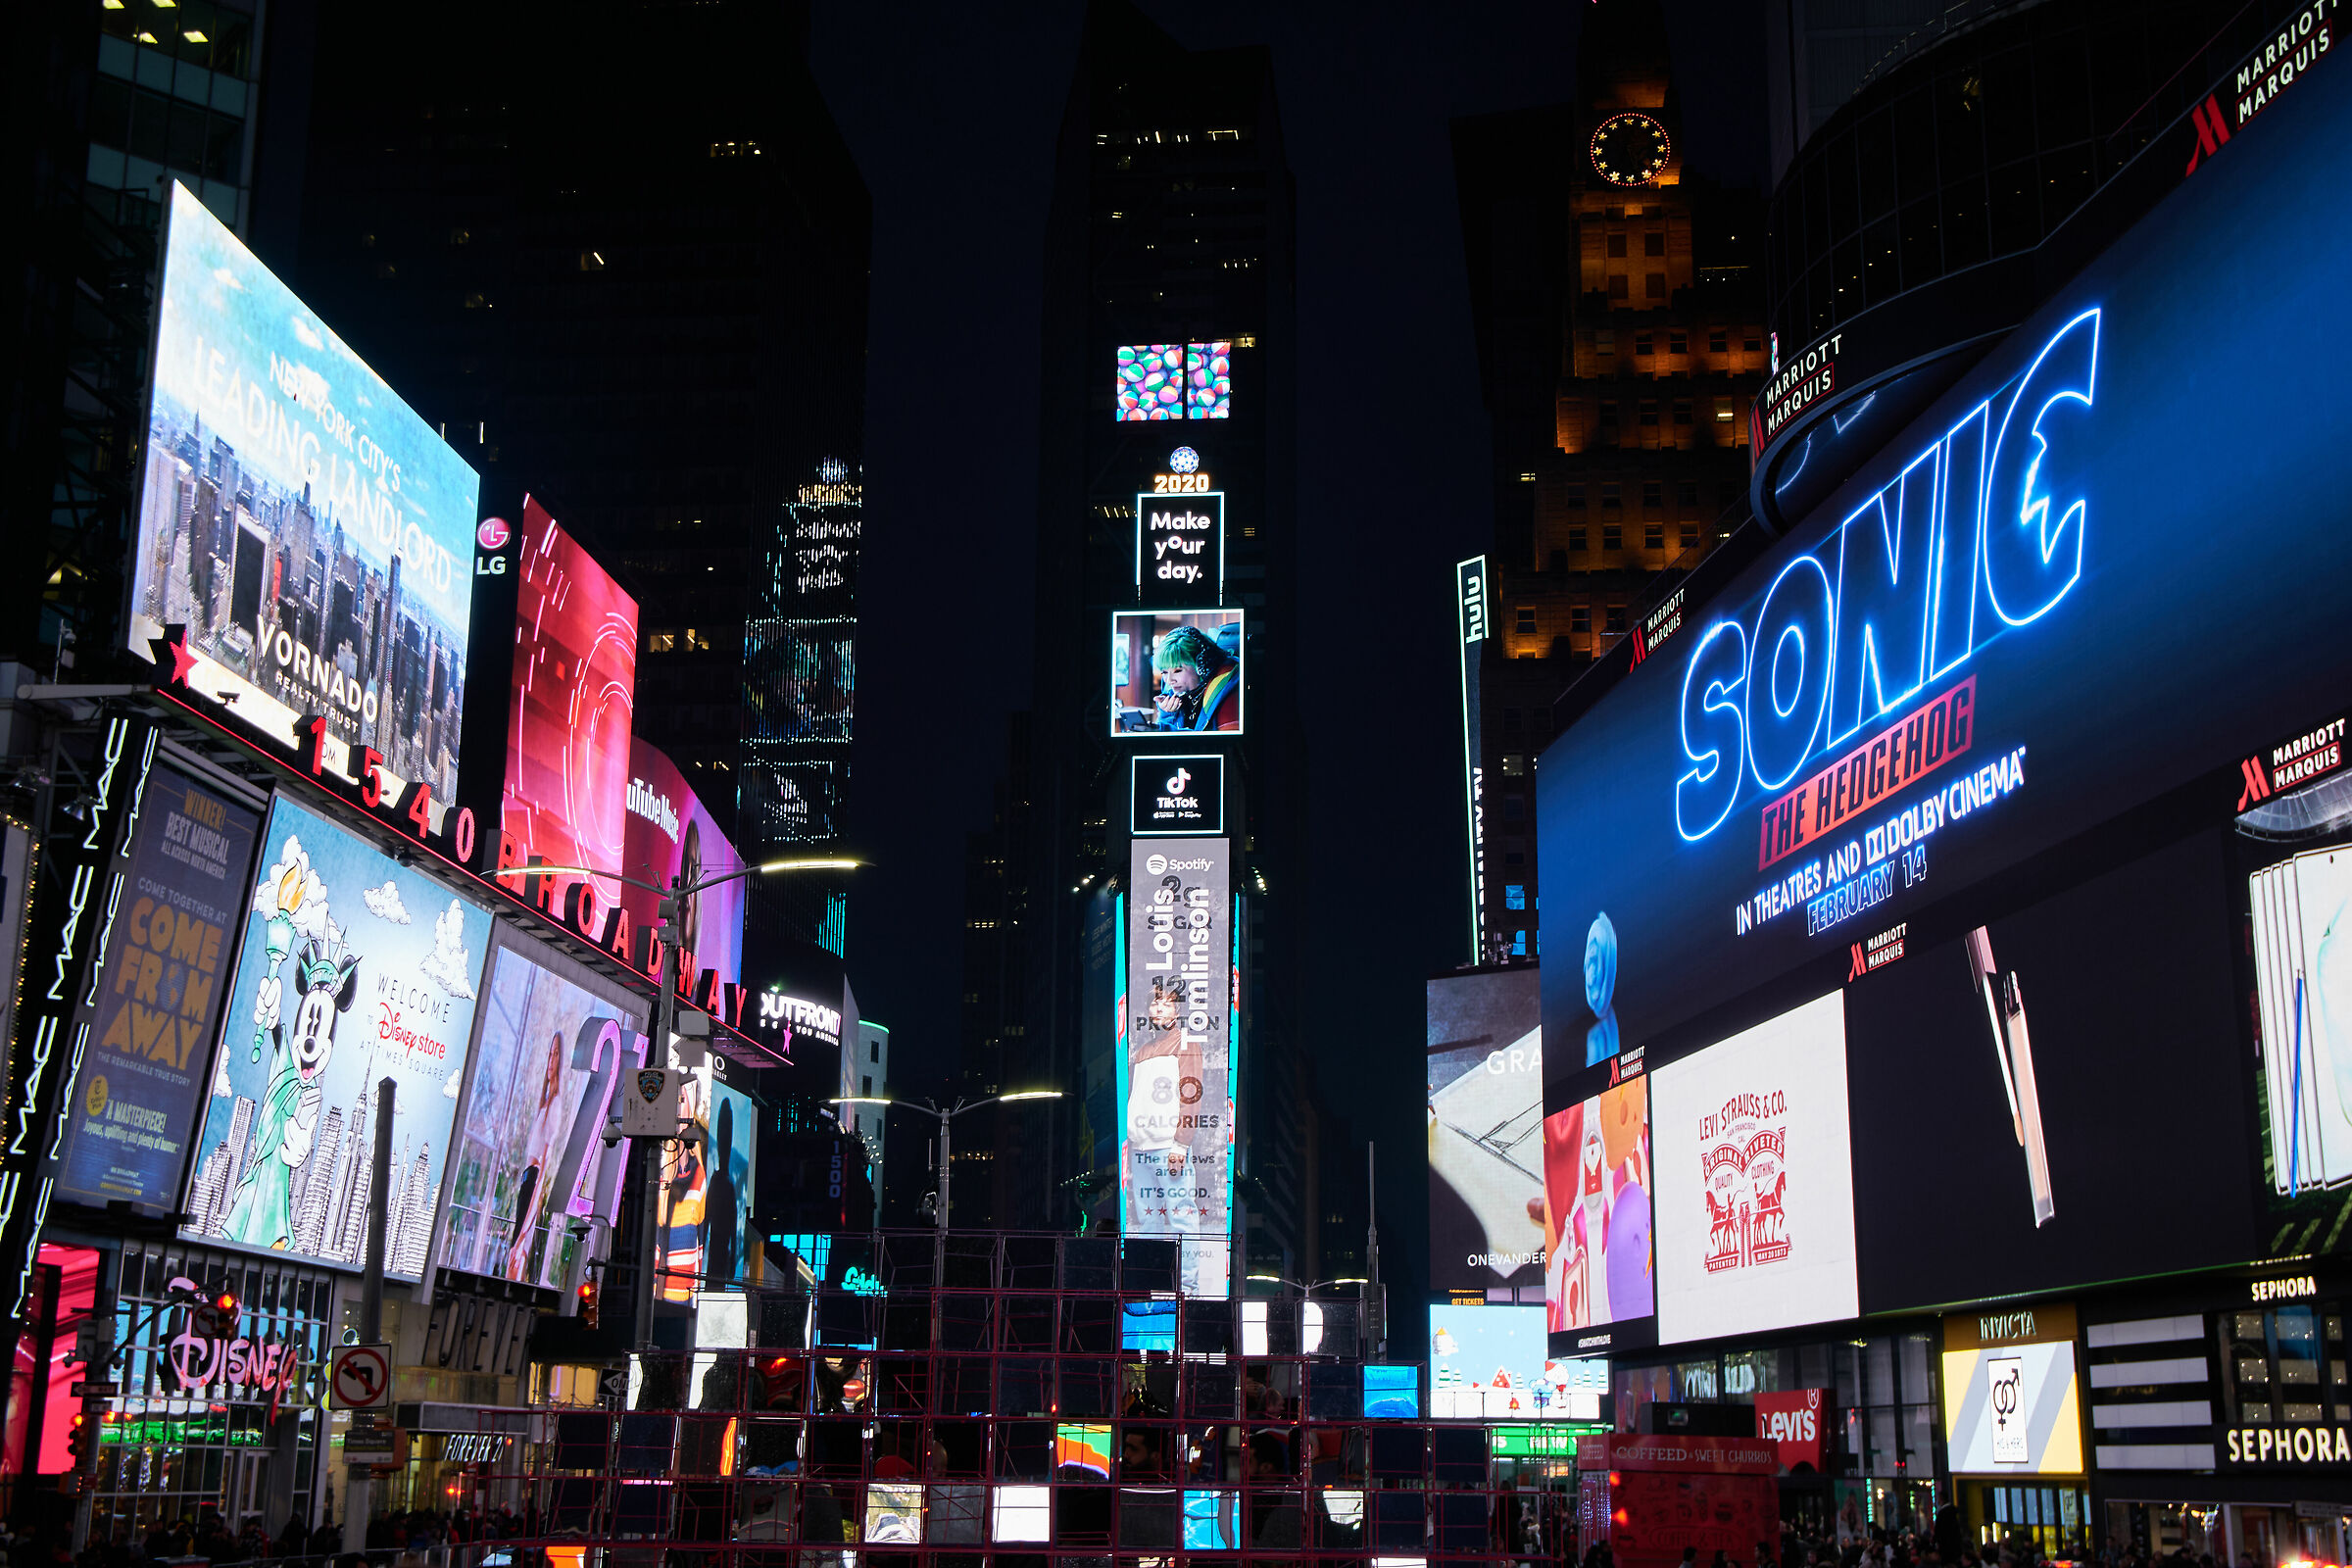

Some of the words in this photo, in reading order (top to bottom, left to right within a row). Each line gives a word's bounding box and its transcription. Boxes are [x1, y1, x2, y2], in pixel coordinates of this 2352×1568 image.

[2236, 0, 2339, 93] MARRIOT
[2238, 26, 2330, 124] MARQUIS
[1766, 333, 1842, 409] MARRIOTT
[194, 335, 321, 483] LEADING
[270, 351, 309, 410] NEW
[312, 390, 356, 454] YORK
[359, 434, 401, 492] CITY'S
[1767, 369, 1832, 436] MARQUIS
[1153, 474, 1209, 493] 2020
[329, 453, 452, 593] LANDLORD
[1150, 511, 1211, 530] Make
[476, 556, 507, 575] LG
[1154, 535, 1205, 561] your
[1157, 561, 1203, 583] day.
[1676, 308, 2101, 841] SONIC
[1463, 576, 1483, 644] hulu
[1647, 588, 1685, 633] MARRIOTT
[1648, 612, 1681, 652] MARQUIS
[257, 613, 378, 723] VORNADO
[274, 670, 319, 708] REALTY
[322, 701, 360, 734] TRUST
[2272, 718, 2346, 766] MARRIOTT
[1763, 789, 1807, 863] THE
[1815, 688, 1972, 833] HEDGEHOG
[2274, 746, 2339, 788] MARQUIS
[183, 788, 227, 832] WINNER!
[1156, 797, 1199, 808] TikTok
[165, 811, 191, 846] BEST
[189, 822, 230, 864] MUSICAL
[1169, 858, 1211, 871] Spotify
[1736, 900, 1752, 936] IN
[1754, 861, 1822, 925] THEATRES
[1826, 841, 1861, 887] AND
[1887, 790, 1948, 856] DOLBY
[138, 877, 168, 899] COME
[168, 889, 215, 921] TOGETHER
[215, 910, 227, 925] AT
[1807, 860, 1894, 937] FEBRUARY
[1902, 845, 1928, 889] 14
[129, 897, 224, 973] COME
[1867, 922, 1908, 952] MARRIOTT
[1868, 941, 1904, 969] MARQUIS
[1146, 889, 1175, 971] Louis
[1180, 889, 1209, 1051] Tomlinson
[377, 972, 451, 1023] WELCOME
[101, 1002, 204, 1071] AWAY
[796, 1025, 813, 1037] YOU
[1136, 1016, 1220, 1031] PROTN
[417, 1032, 446, 1059] store
[1620, 1046, 1645, 1067] MARRIOTT
[98, 1052, 110, 1064] THE
[111, 1054, 153, 1076] REMARKABLE
[154, 1066, 171, 1080] TRUE
[171, 1072, 191, 1087] STORY
[1621, 1059, 1643, 1080] MARQUIS
[1152, 1076, 1203, 1105] 80
[113, 1102, 168, 1134] MASTERPIECE!
[1135, 1114, 1219, 1129] CALORIES
[1699, 1113, 1719, 1141] LEVI
[1721, 1093, 1761, 1132] STRAUSS
[1763, 1095, 1770, 1119] &
[1772, 1089, 1787, 1116] CO.
[829, 1141, 842, 1199] 1500
[1135, 1152, 1160, 1164] The
[1162, 1152, 1215, 1164] reviews
[1155, 1168, 1178, 1177] are
[1704, 1147, 1743, 1175] ORIGINAL
[1744, 1134, 1784, 1164] RIVETED
[1140, 1188, 1164, 1199] IT'S
[1167, 1188, 1210, 1199] GOOD.
[1715, 1173, 1734, 1193] QUALITY
[1751, 1160, 1775, 1180] CLOTHING
[2251, 1276, 2317, 1301] SEPHORA
[1979, 1311, 2036, 1341] INVICTA
[444, 1434, 493, 1462] FOREVER
[1616, 1446, 1688, 1461] COFFEED
[1694, 1449, 1725, 1463] SWEET
[1728, 1449, 1772, 1464] CHURROS
[2228, 1428, 2352, 1462] SEPHORA
